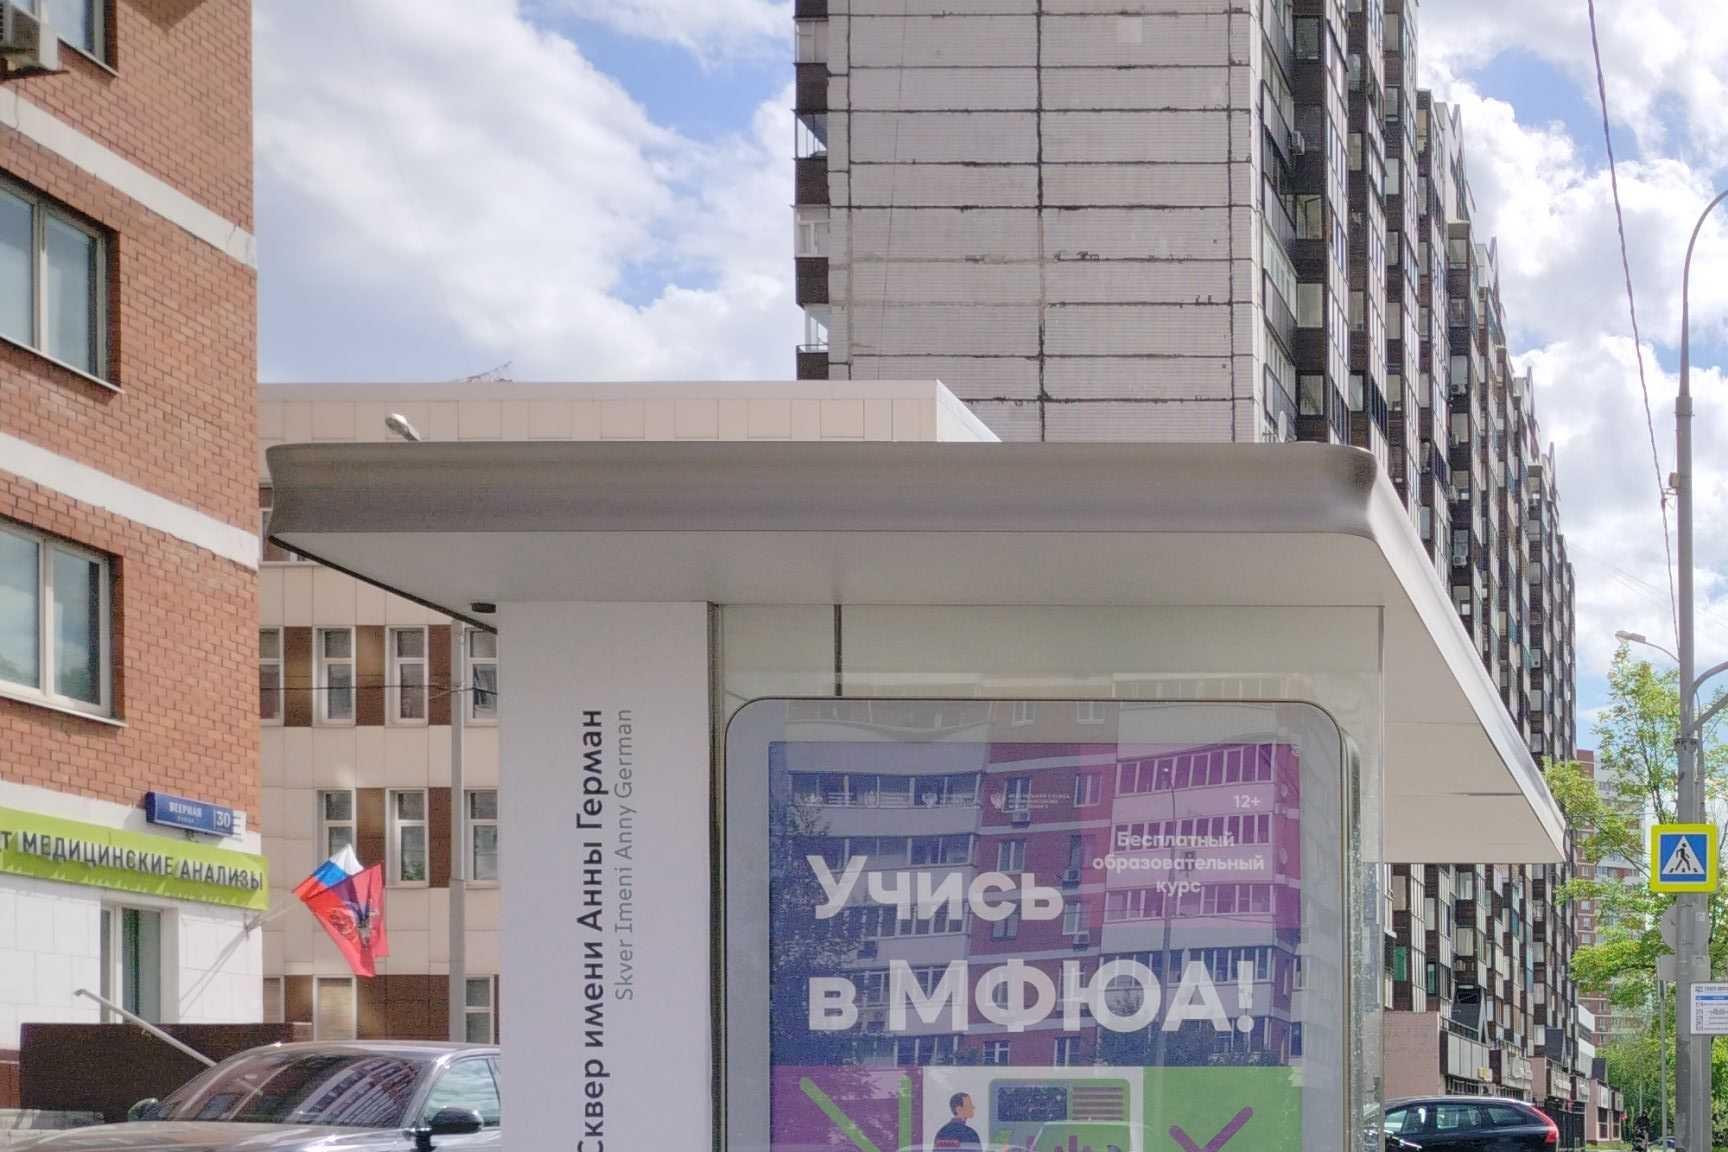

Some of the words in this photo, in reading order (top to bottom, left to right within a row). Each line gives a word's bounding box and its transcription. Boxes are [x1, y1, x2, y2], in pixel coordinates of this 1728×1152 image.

[575, 710, 609, 829] Герман
[613, 709, 633, 798] German
[215, 810, 232, 829] 30
[614, 805, 637, 860] Anny
[1232, 794, 1262, 809] 12+
[23, 830, 174, 876] МЕДИЦИНСКИЕ
[180, 858, 263, 890] АНАЛИЗЫ
[1092, 853, 1265, 873] образовательный
[1117, 831, 1235, 848] Бесплатный
[575, 842, 603, 932] Анны
[614, 866, 633, 933] Imeni
[806, 855, 1064, 921] Учись
[1156, 880, 1201, 897] курс
[583, 941, 604, 1048] имени
[613, 939, 634, 1001] Skver
[808, 976, 859, 1031] в
[888, 958, 1255, 1034] МФЮА!
